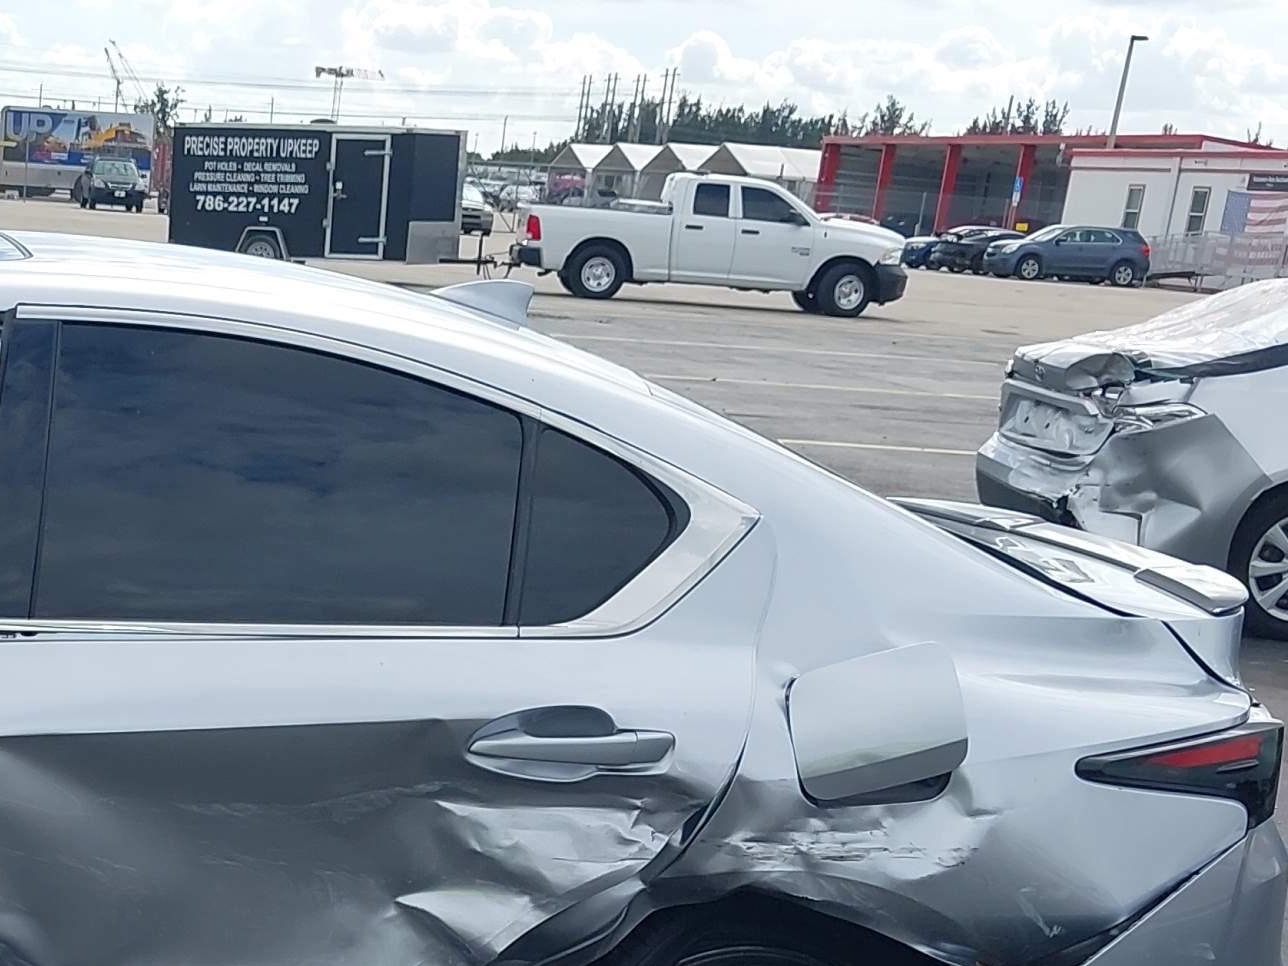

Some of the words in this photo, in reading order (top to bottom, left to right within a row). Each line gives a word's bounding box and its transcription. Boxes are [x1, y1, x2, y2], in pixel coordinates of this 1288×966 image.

[184, 135, 225, 156] PRECISE
[226, 136, 279, 158] PROPERTY
[280, 138, 320, 159] UPKEEP
[204, 161, 216, 170] POT
[217, 161, 237, 171] HOLES
[243, 162, 263, 171] DECAL
[263, 162, 296, 172] REMOVALS
[194, 171, 225, 181] PRESSURE
[225, 172, 255, 182] CLEANING
[260, 173, 275, 182] TREE
[189, 182, 207, 191] LAWN
[207, 182, 249, 193] MAINTENANCE
[253, 184, 279, 193] WINDOW
[279, 184, 309, 194] CLEANING
[196, 195, 300, 213] 786-227-1147
